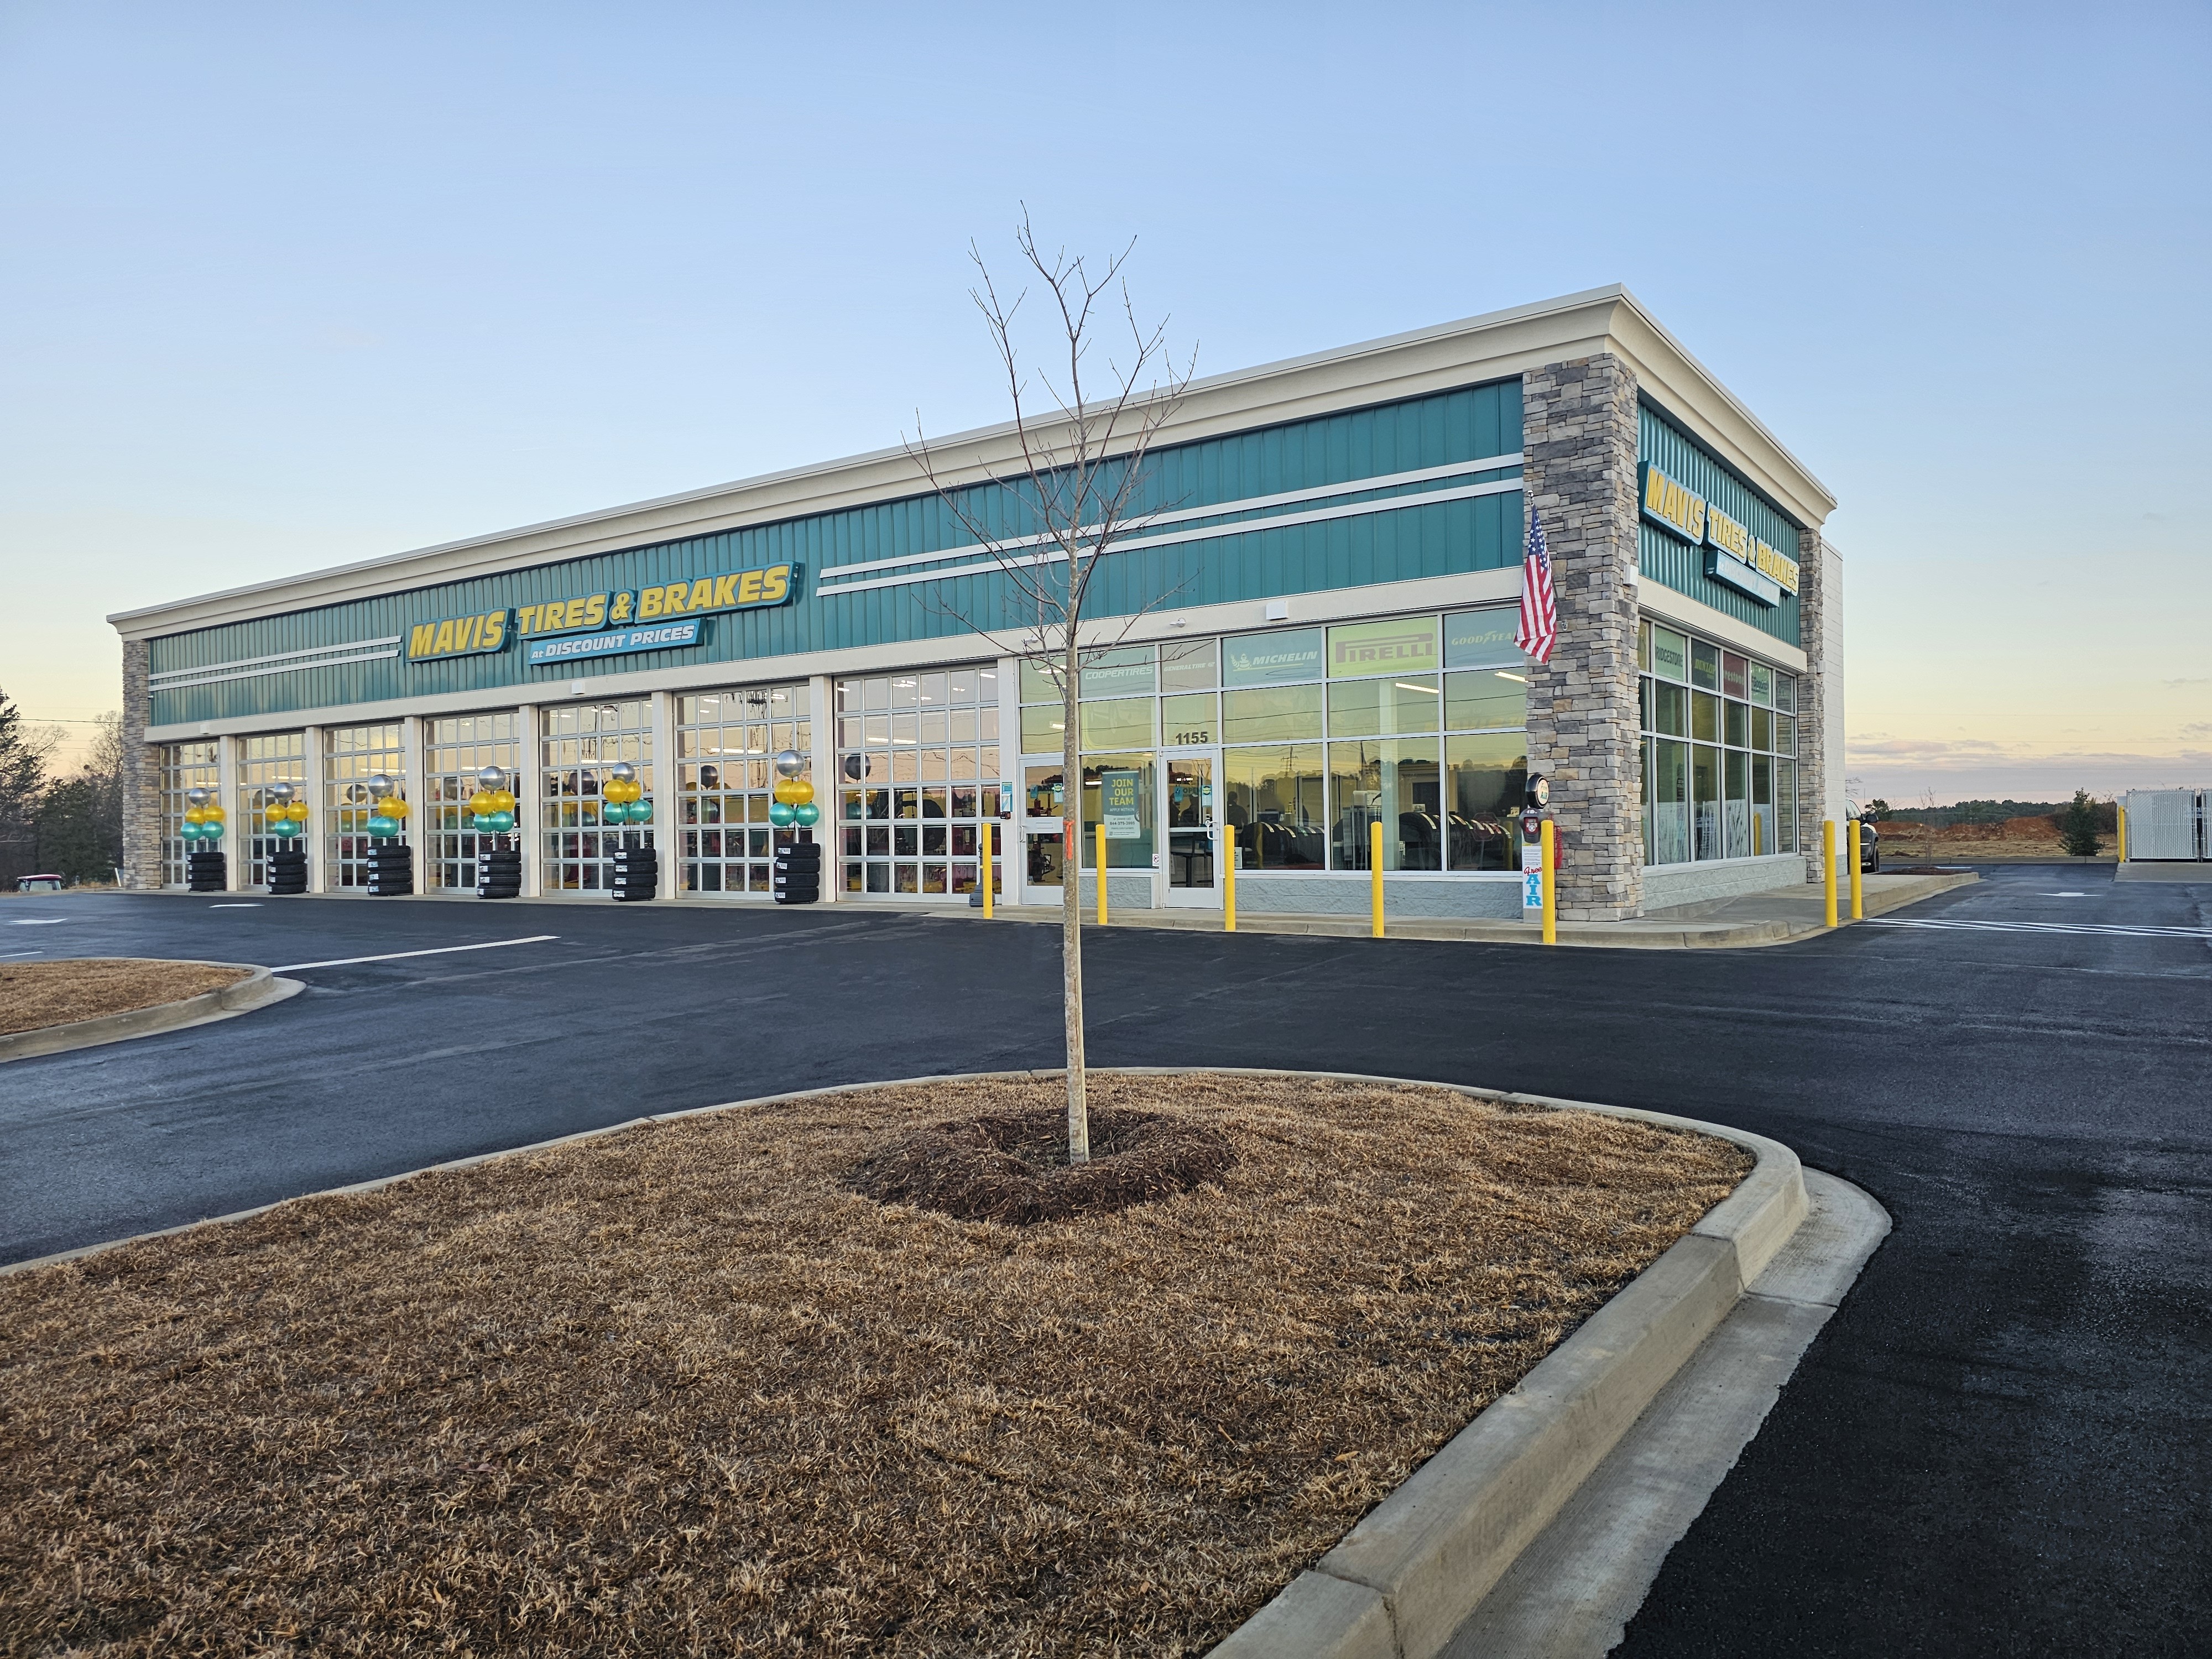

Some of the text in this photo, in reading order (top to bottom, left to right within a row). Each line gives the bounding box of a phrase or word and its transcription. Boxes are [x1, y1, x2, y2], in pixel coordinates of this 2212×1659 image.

[1647, 468, 1704, 538] MAVIS
[1709, 508, 1747, 559] TIRES
[1748, 538, 1755, 563] &
[1757, 542, 1799, 593] BRAKES
[408, 564, 790, 658] MAVIS TIRES & BRAKES
[531, 624, 696, 659] At DISCOUNT PRICES
[1451, 631, 1516, 646] GOODYEA
[1252, 651, 1318, 665] MICHELIN
[1335, 633, 1433, 664] PIRELLI
[1655, 643, 1683, 667] RIDGESTONE
[1176, 731, 1208, 745] 1155
[1112, 779, 1133, 787] JOIN
[1115, 788, 1134, 796] OUR
[1109, 797, 1134, 806] TEAM
[1526, 874, 1542, 906] AIR
